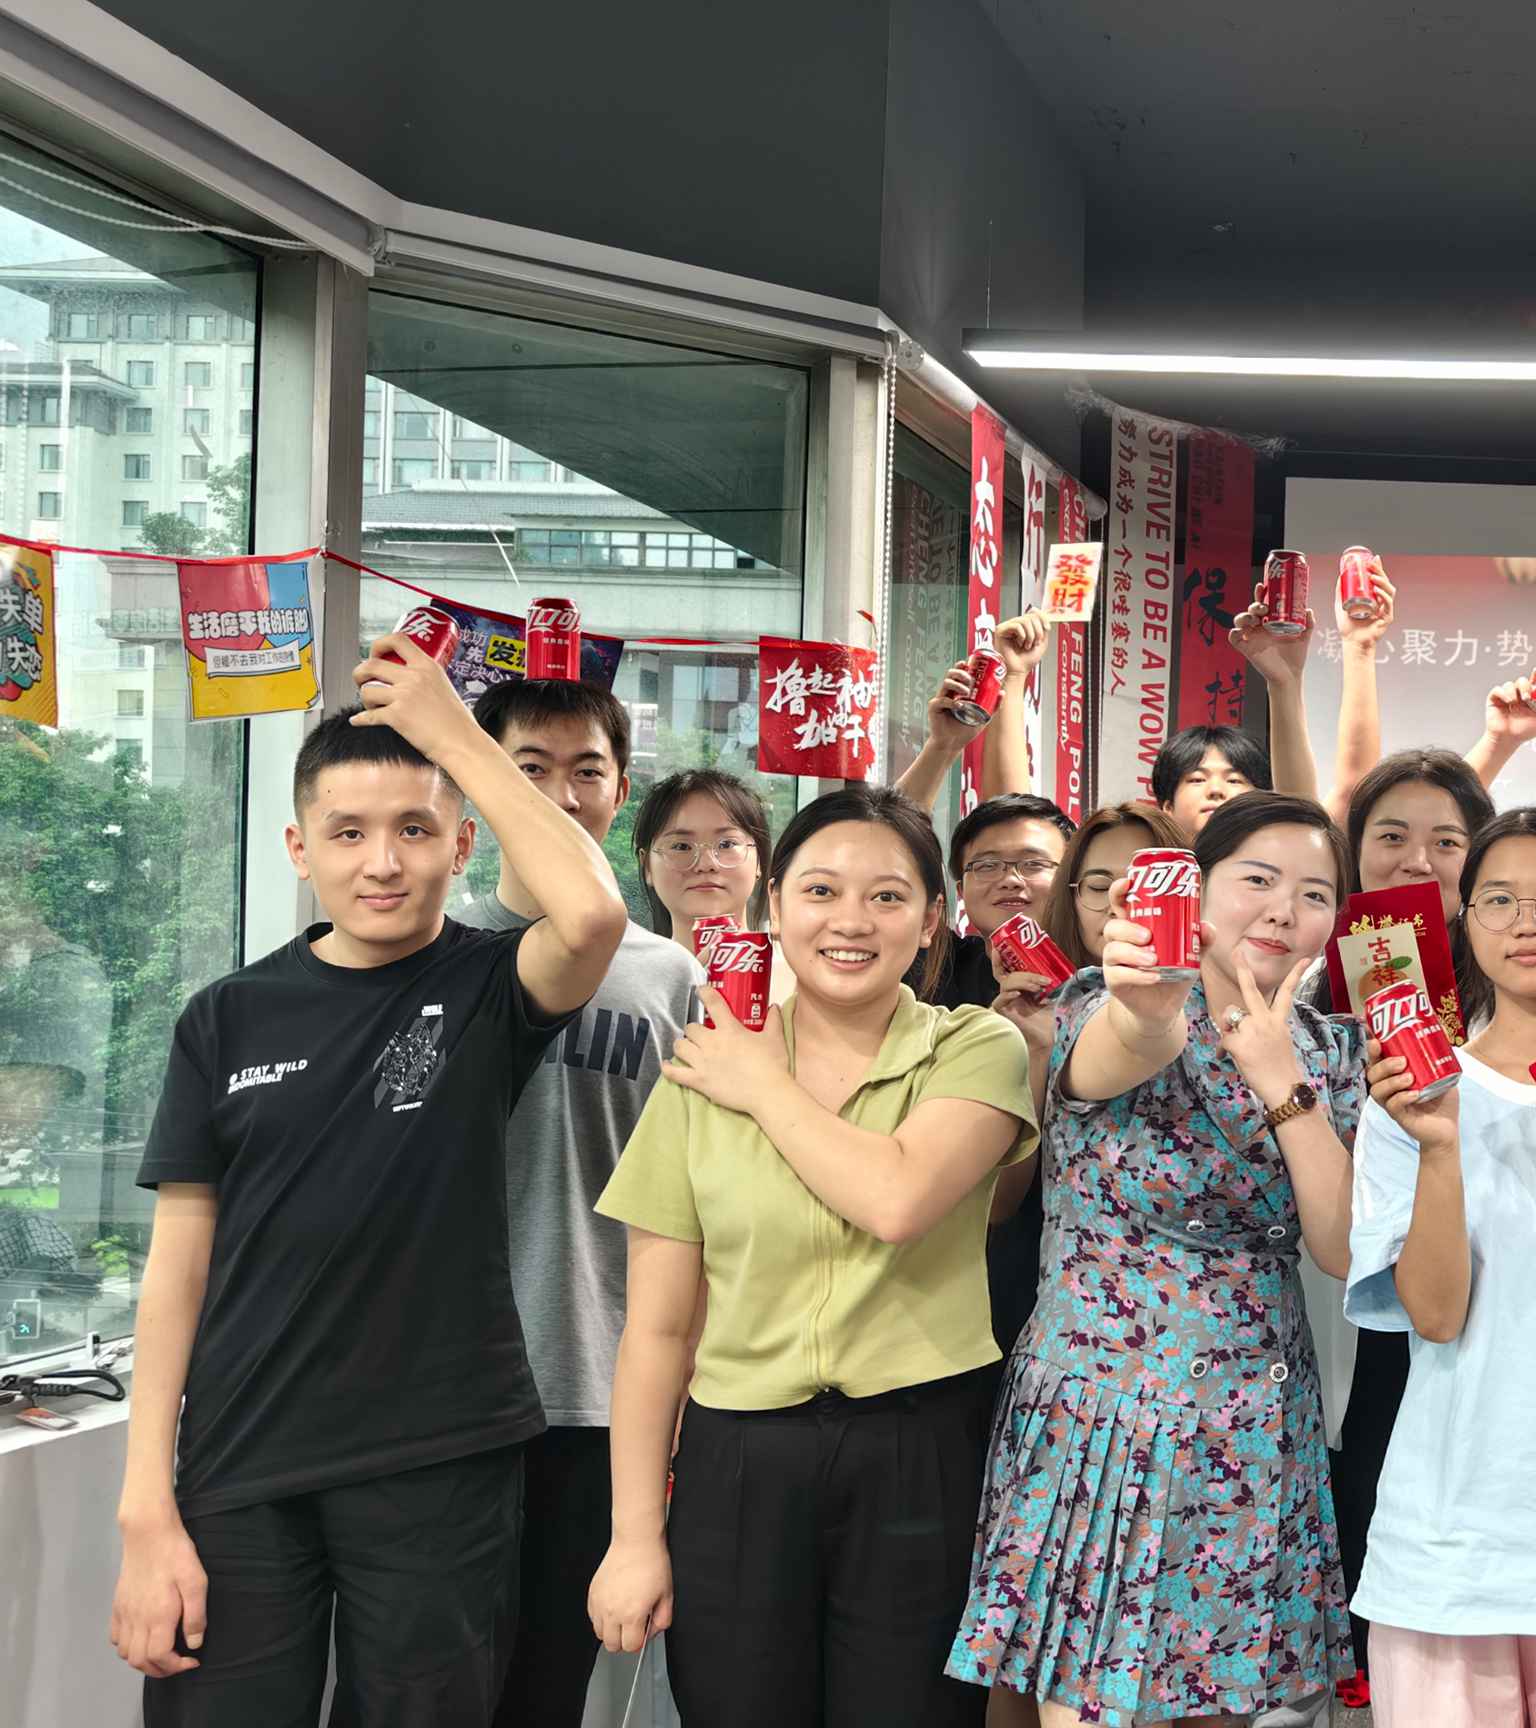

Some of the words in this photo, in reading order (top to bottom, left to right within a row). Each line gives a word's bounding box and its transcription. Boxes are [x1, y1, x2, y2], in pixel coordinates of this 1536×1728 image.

[1145, 426, 1174, 543] STRIVE
[1051, 553, 1093, 613] 發財
[1144, 551, 1170, 591] TO
[1142, 600, 1169, 643] BE
[1069, 627, 1085, 725] FENG
[1141, 648, 1167, 670] A
[1137, 682, 1166, 766] WOW
[1067, 746, 1083, 830] POL
[240, 1065, 270, 1079] STAY
[274, 1059, 308, 1074] WILD
[544, 1008, 650, 1082] LIN
